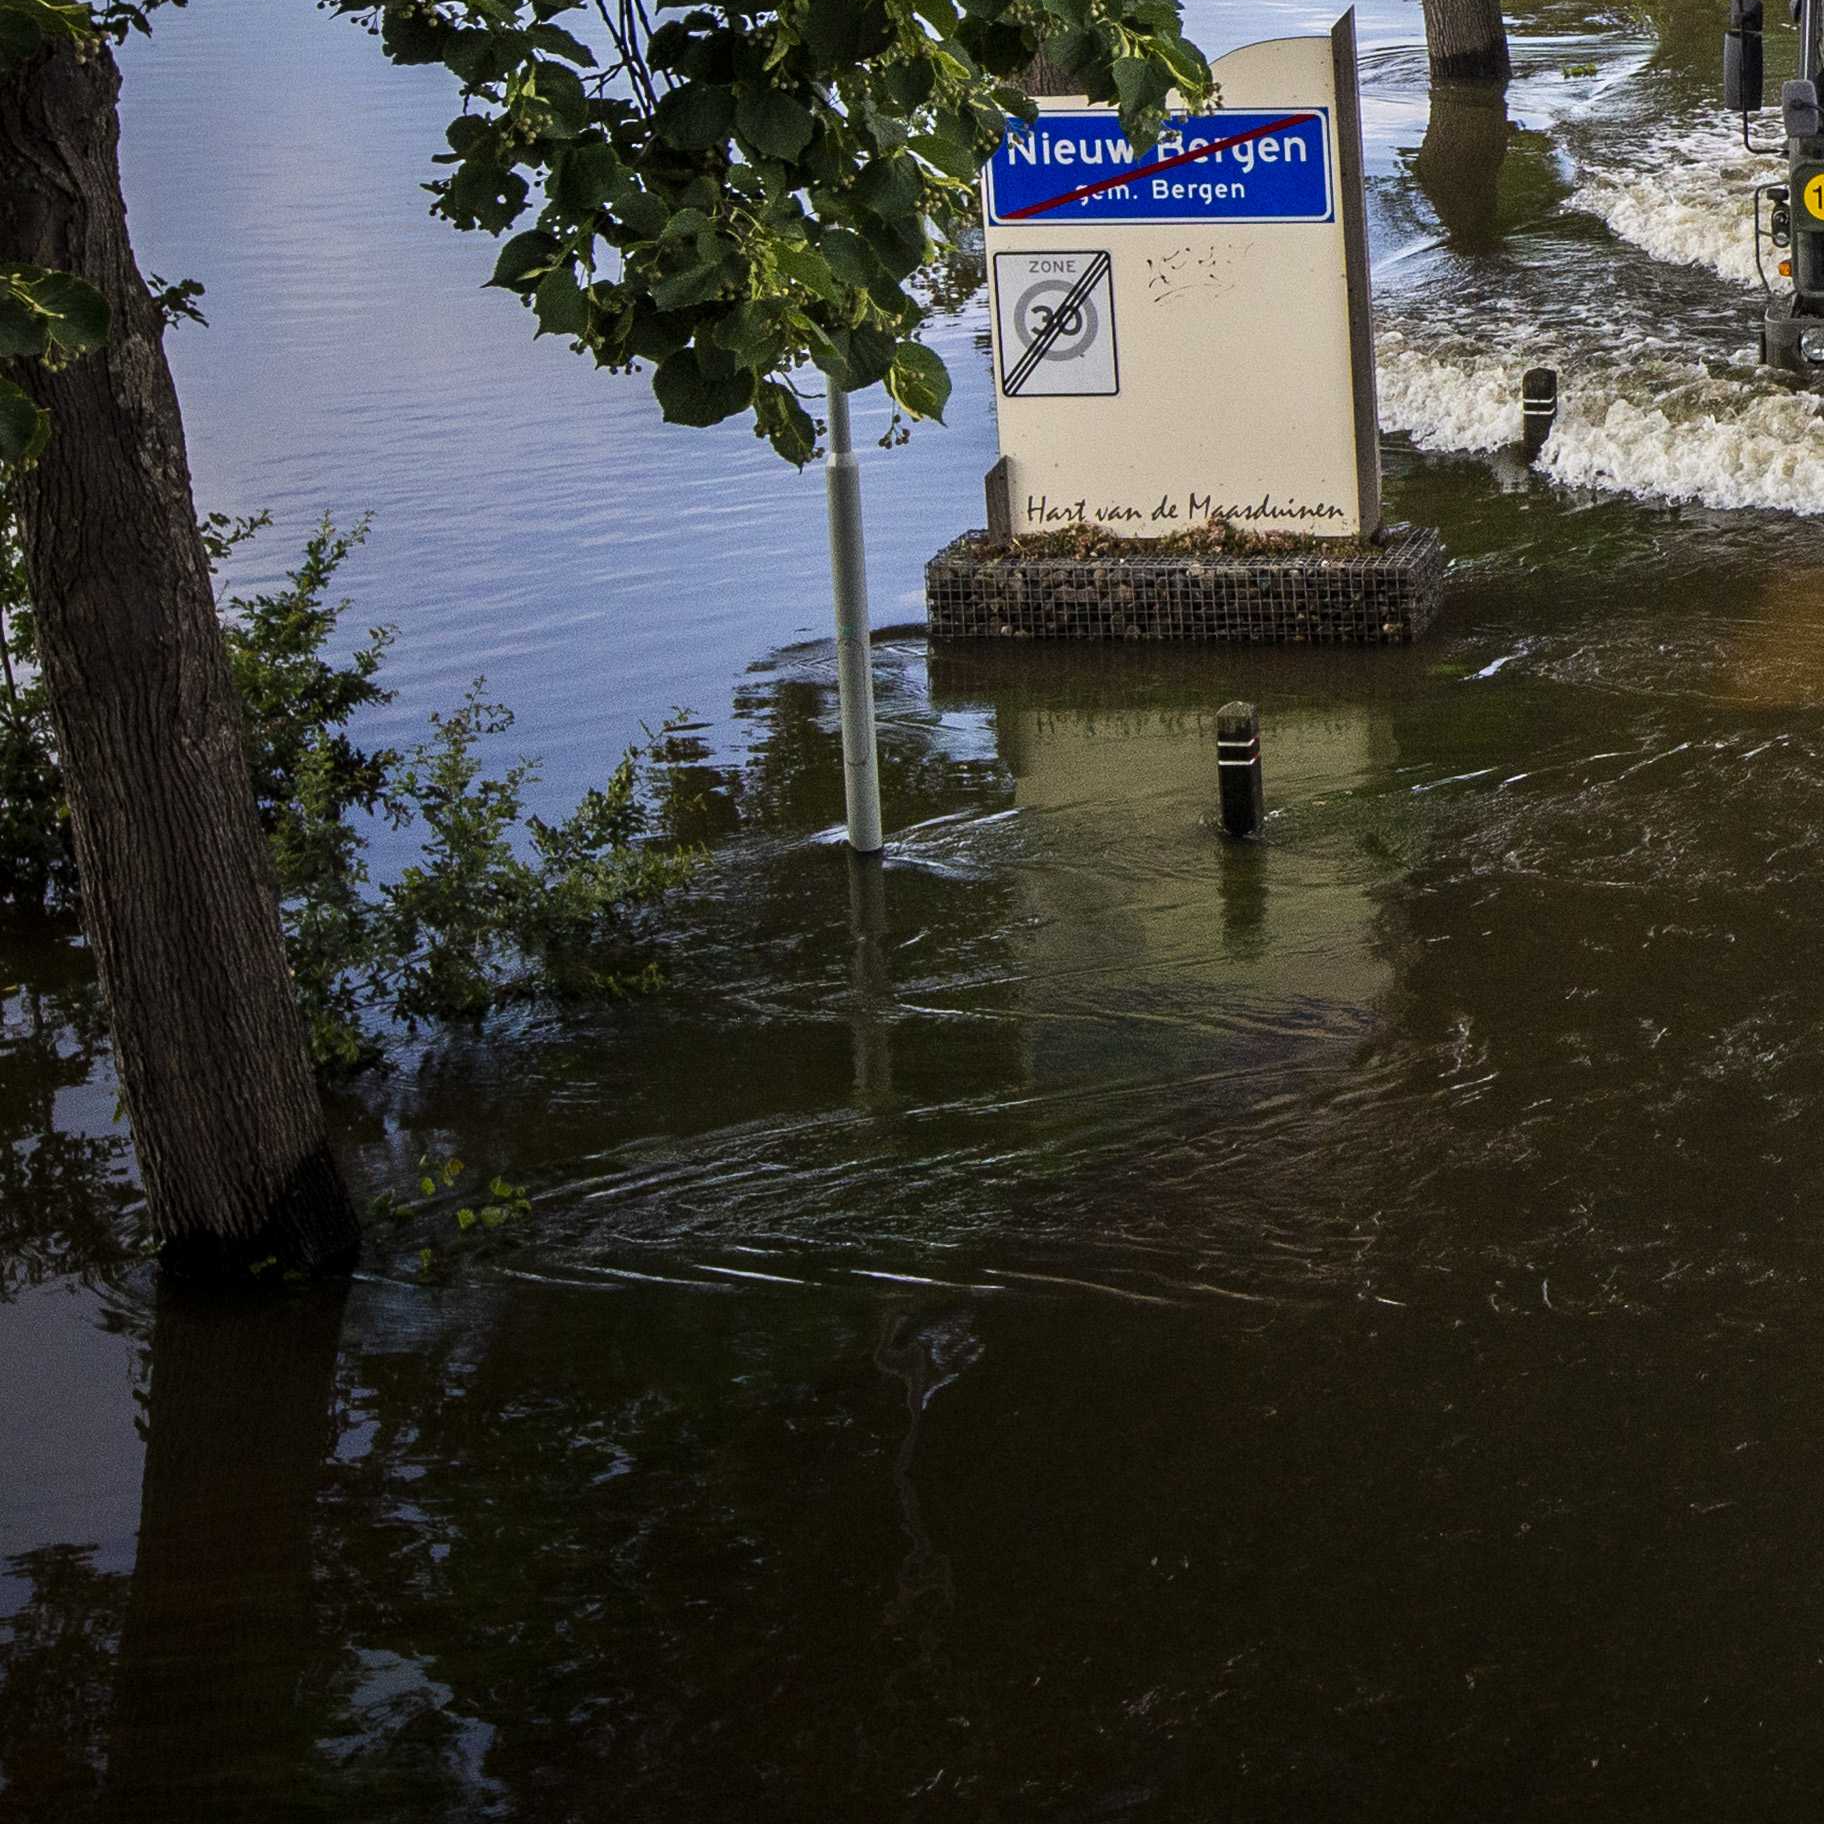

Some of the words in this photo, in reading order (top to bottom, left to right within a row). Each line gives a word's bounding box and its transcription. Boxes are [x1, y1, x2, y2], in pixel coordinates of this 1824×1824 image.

[1007, 131, 1135, 165] Nieuw
[1157, 129, 1307, 174] Bergen
[1151, 179, 1246, 205] Bergen
[1028, 259, 1077, 274] ZONE
[1031, 304, 1083, 336] 30
[1026, 495, 1087, 522] Hart
[1096, 504, 1142, 522] van
[1151, 495, 1179, 522] de
[1188, 492, 1345, 522] Maasduinen
